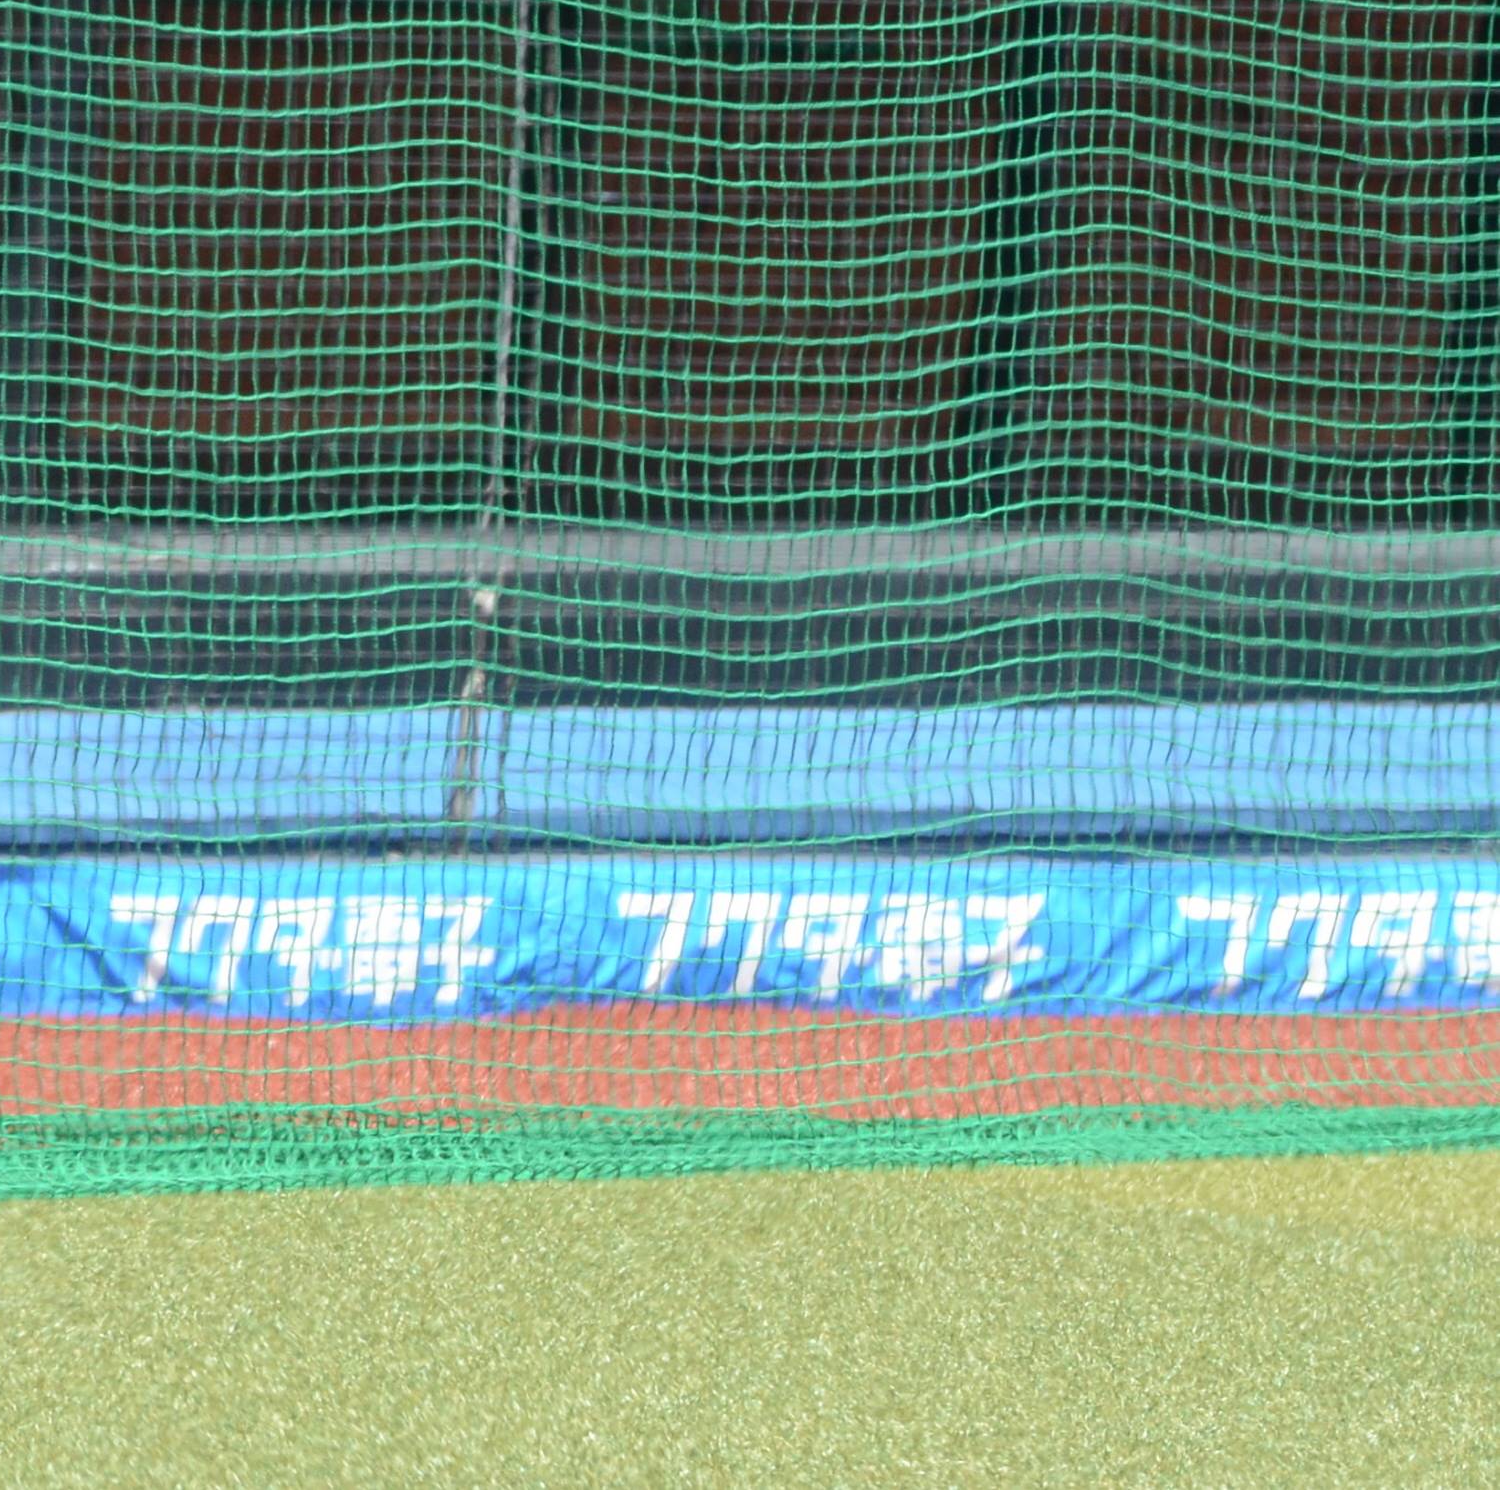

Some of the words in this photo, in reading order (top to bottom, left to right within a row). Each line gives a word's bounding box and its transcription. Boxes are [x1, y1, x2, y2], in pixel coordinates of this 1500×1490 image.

[109, 894, 497, 1006] フクダ電子
[617, 891, 1045, 1001] フクダ電子
